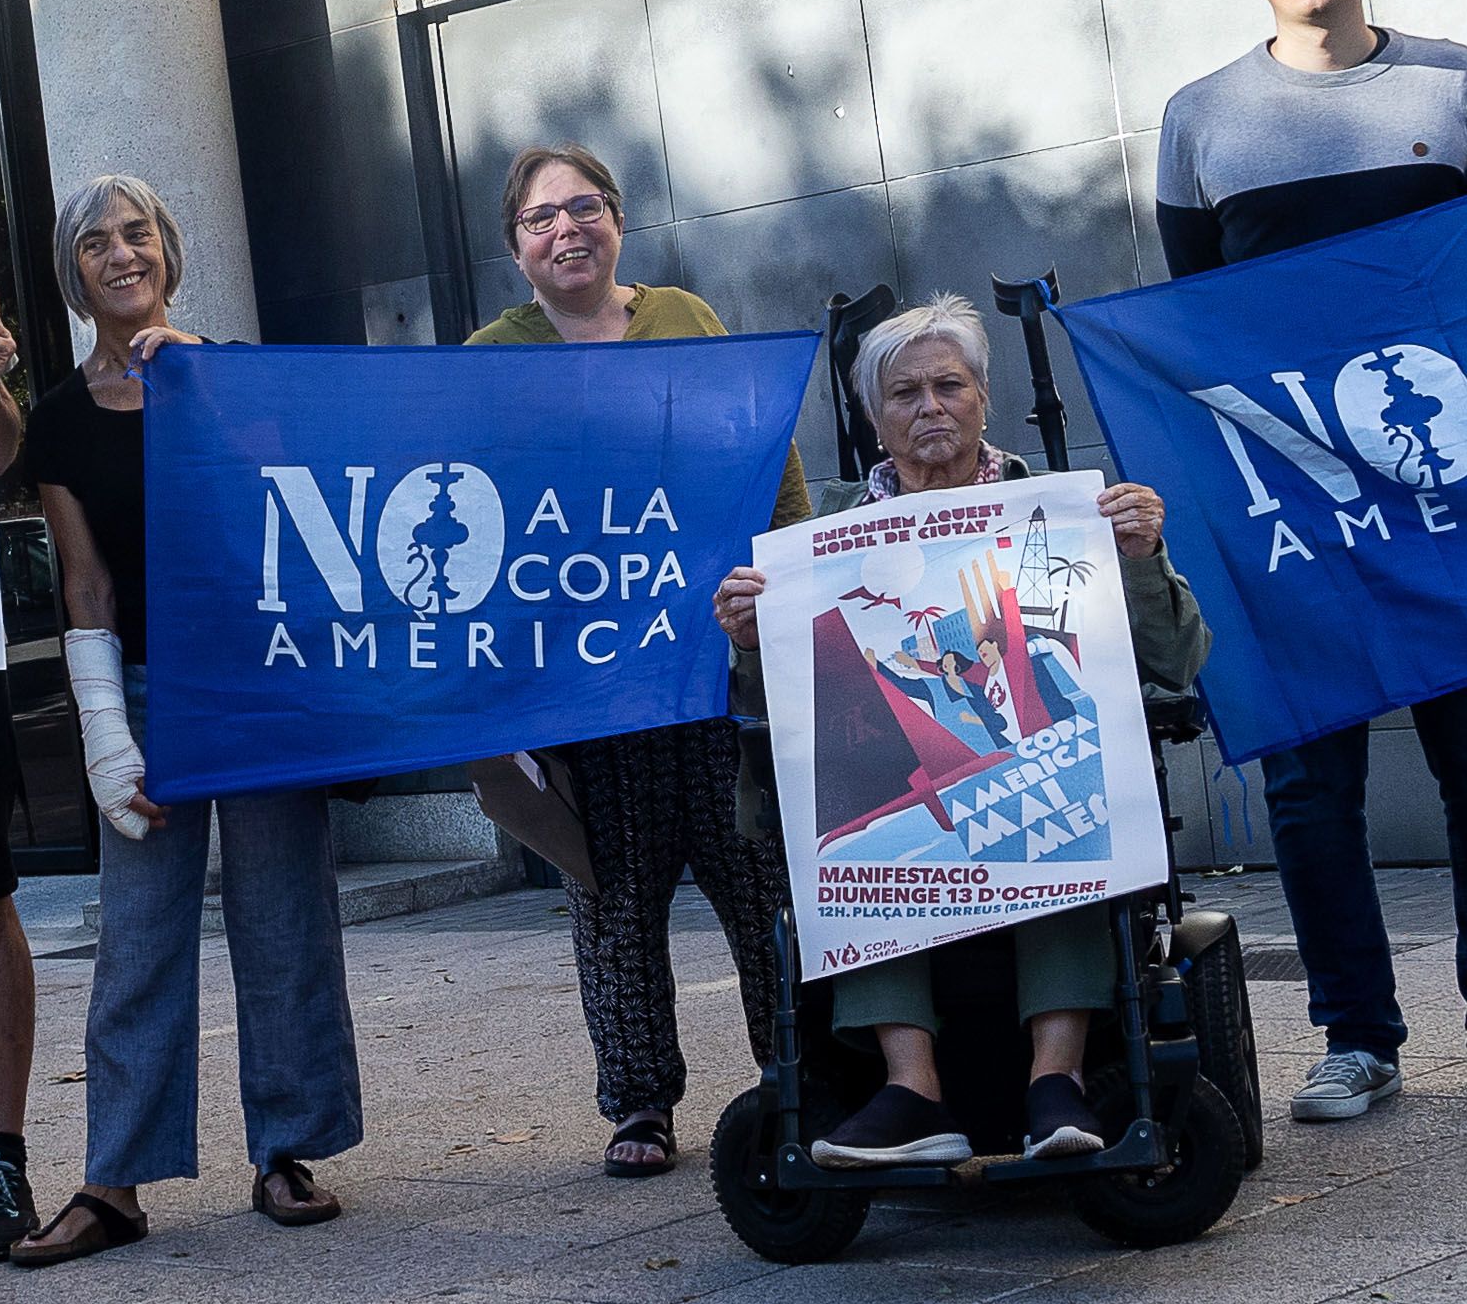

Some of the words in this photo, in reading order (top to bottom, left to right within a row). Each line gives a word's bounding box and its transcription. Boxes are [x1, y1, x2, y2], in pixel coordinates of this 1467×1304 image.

[525, 488, 570, 535] A
[603, 487, 679, 535] LA
[812, 515, 916, 544] ENFONSEM
[924, 503, 1004, 525] AQUEST
[257, 463, 505, 614] NO
[813, 534, 877, 557] MODEL
[885, 530, 910, 544] DE
[918, 520, 988, 539] CIUTAT
[507, 551, 687, 601] COPA
[264, 609, 676, 669] AMÈRICA
[1017, 714, 1097, 759] COPA
[968, 777, 1069, 856] MAI
[818, 864, 989, 885] MANIFESTACIÓ
[818, 887, 943, 904] DIUMENGE
[947, 887, 973, 903] 13
[979, 880, 1107, 902] D'OCTUBRE
[818, 906, 850, 917] 12H.
[853, 907, 903, 920] PLAÇA
[907, 907, 926, 917] DE
[930, 904, 1001, 917] CORREUS
[864, 939, 898, 953] COPA
